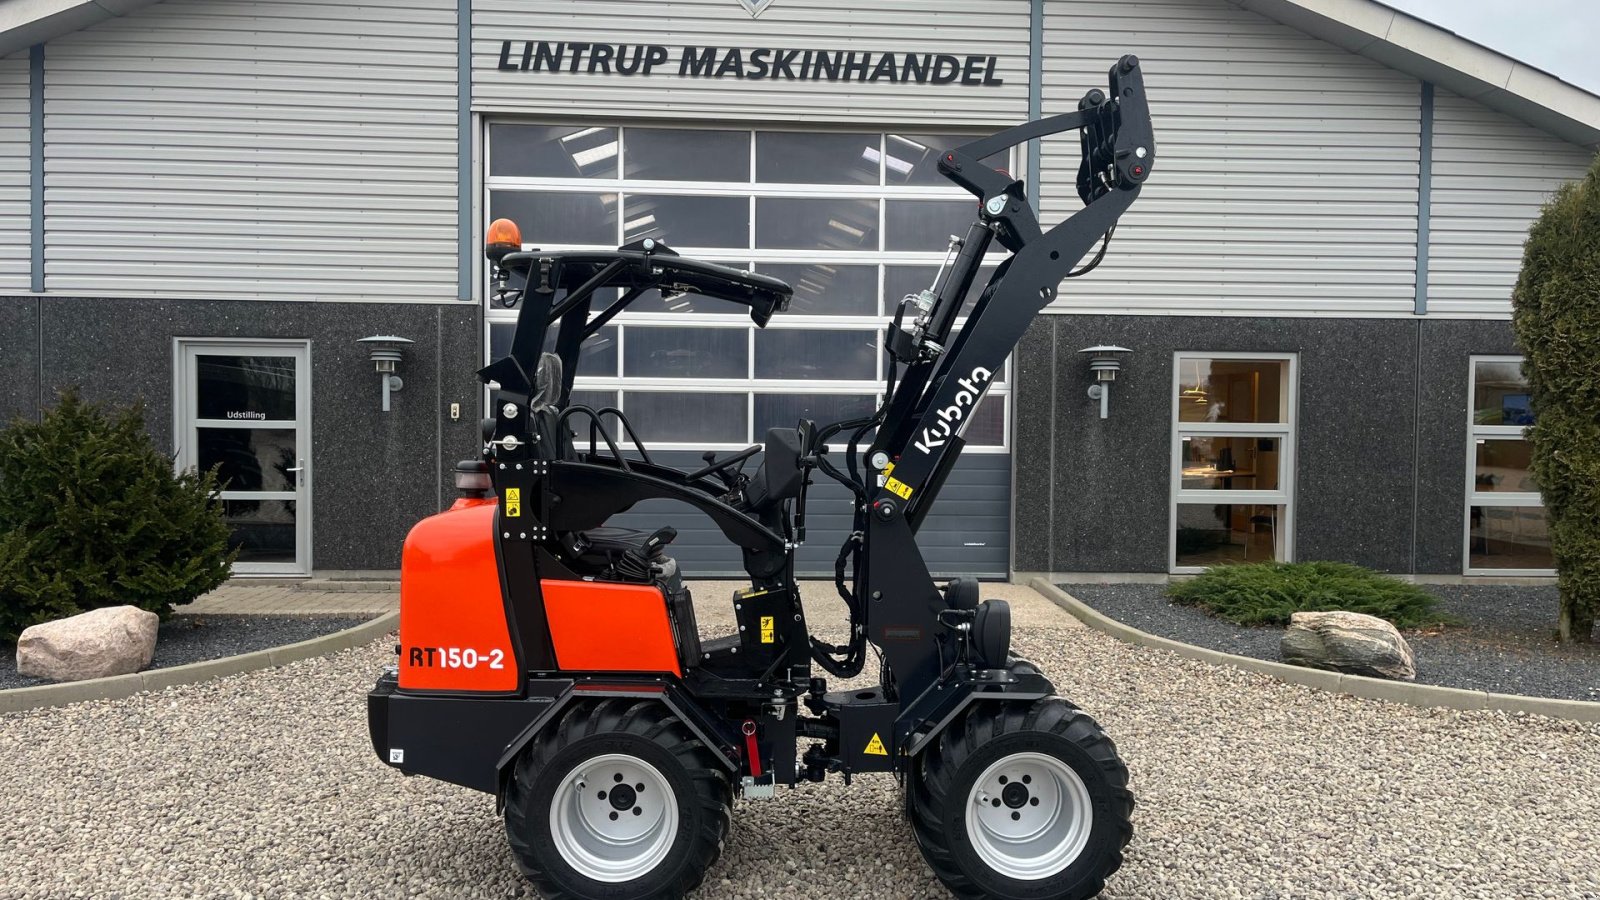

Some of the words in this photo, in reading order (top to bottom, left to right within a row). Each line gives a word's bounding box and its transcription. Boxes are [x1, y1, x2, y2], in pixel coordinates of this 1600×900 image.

[498, 40, 668, 75] LINTRUP
[678, 46, 1003, 86] MASKINHANDEL
[227, 411, 266, 420] Udstilling
[914, 367, 991, 454] Kubota
[410, 647, 504, 669] RT150-2
